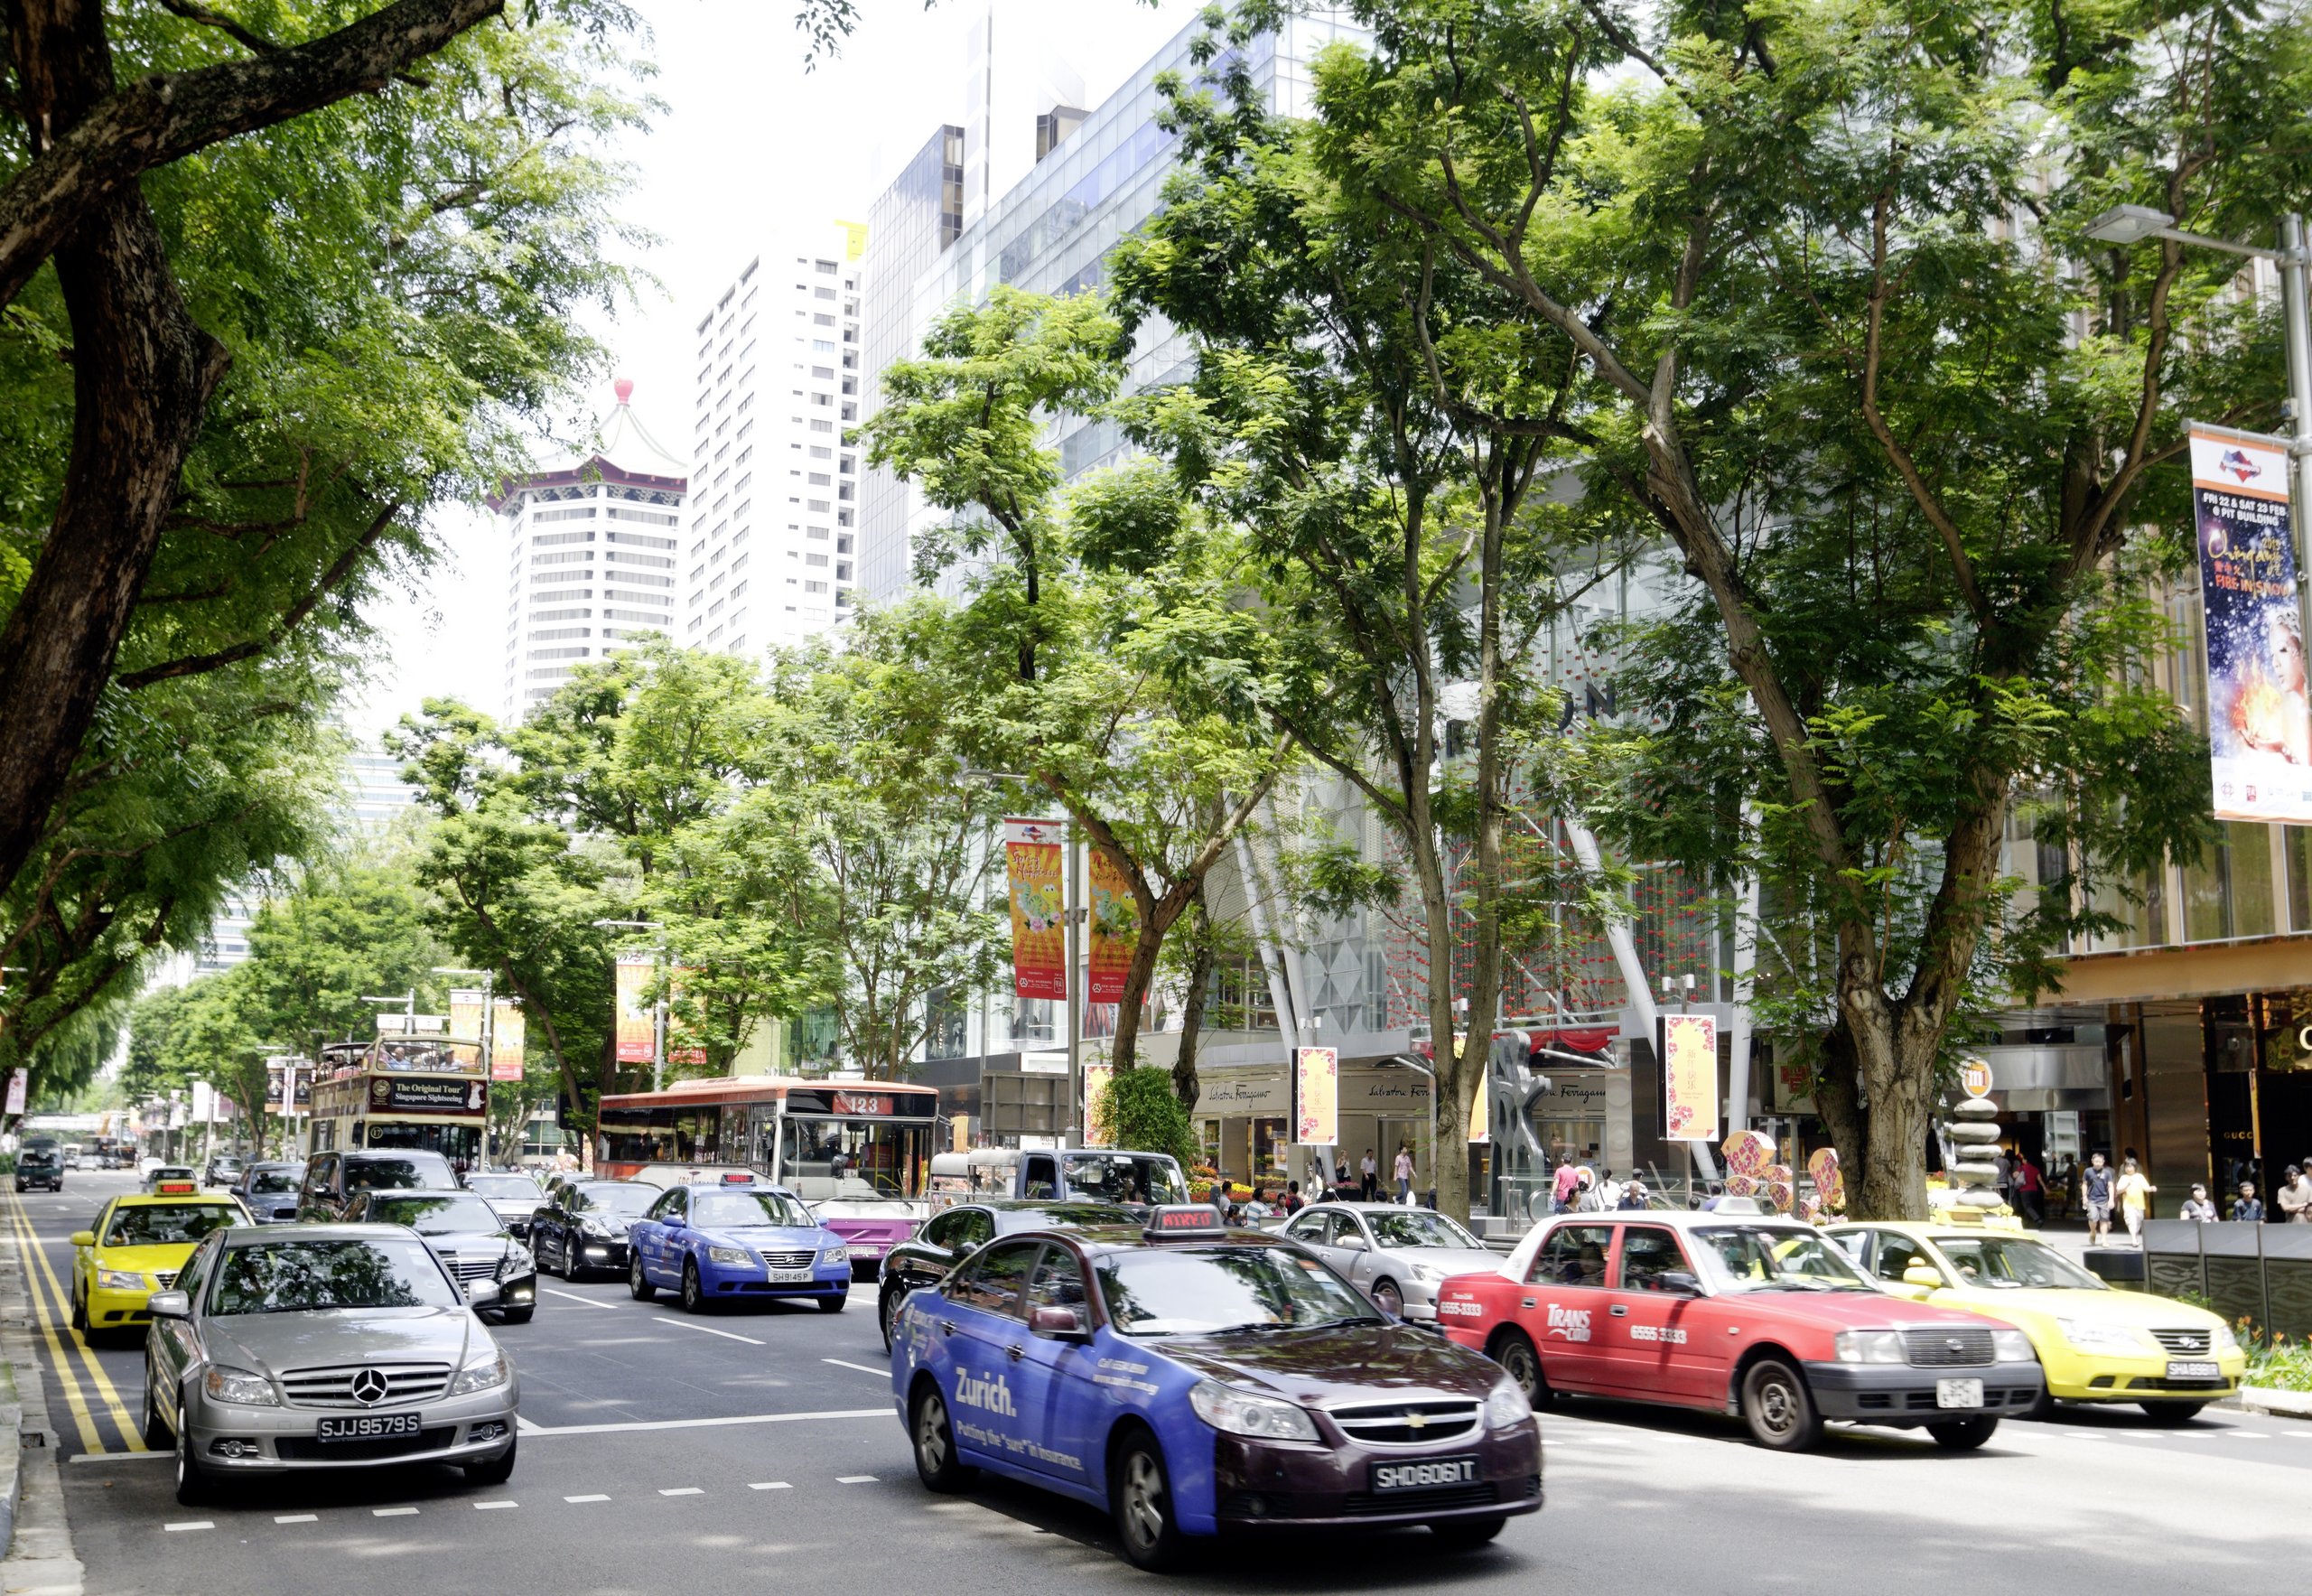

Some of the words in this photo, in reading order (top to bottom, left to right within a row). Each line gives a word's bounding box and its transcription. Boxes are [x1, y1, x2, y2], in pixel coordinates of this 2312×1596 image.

[2203, 492, 2218, 504] FRI
[2219, 495, 2230, 506] 22
[2231, 498, 2238, 508] &
[2240, 499, 2256, 511] SAT
[2257, 502, 2268, 513] 23
[2270, 504, 2286, 516] FEB
[2221, 508, 2235, 518] PIT
[2237, 510, 2279, 526] BUILDING
[2215, 574, 2238, 590] FIRE
[2241, 579, 2253, 592] IN
[2256, 581, 2289, 597] SNOW
[395, 1092, 427, 1102] Singapore
[428, 1094, 462, 1104] Sightseeing
[396, 1083, 410, 1091] The
[411, 1084, 442, 1094] Original
[443, 1086, 463, 1094] Tour
[1209, 1086, 1235, 1101] Salvatore
[1235, 1085, 1271, 1108] Ferragamo
[1369, 1085, 1408, 1097] Salvatore
[1561, 1085, 1605, 1104] Ferragam
[851, 1097, 878, 1113] 123
[2224, 1132, 2252, 1140] GUCC
[1547, 1303, 1592, 1328] TRANS
[956, 1367, 1017, 1417] Zurich.
[321, 1415, 418, 1437] SJJ9579S
[956, 1420, 987, 1445] Putting
[986, 1429, 1002, 1446] the
[1376, 1461, 1475, 1488] SHD6061T
